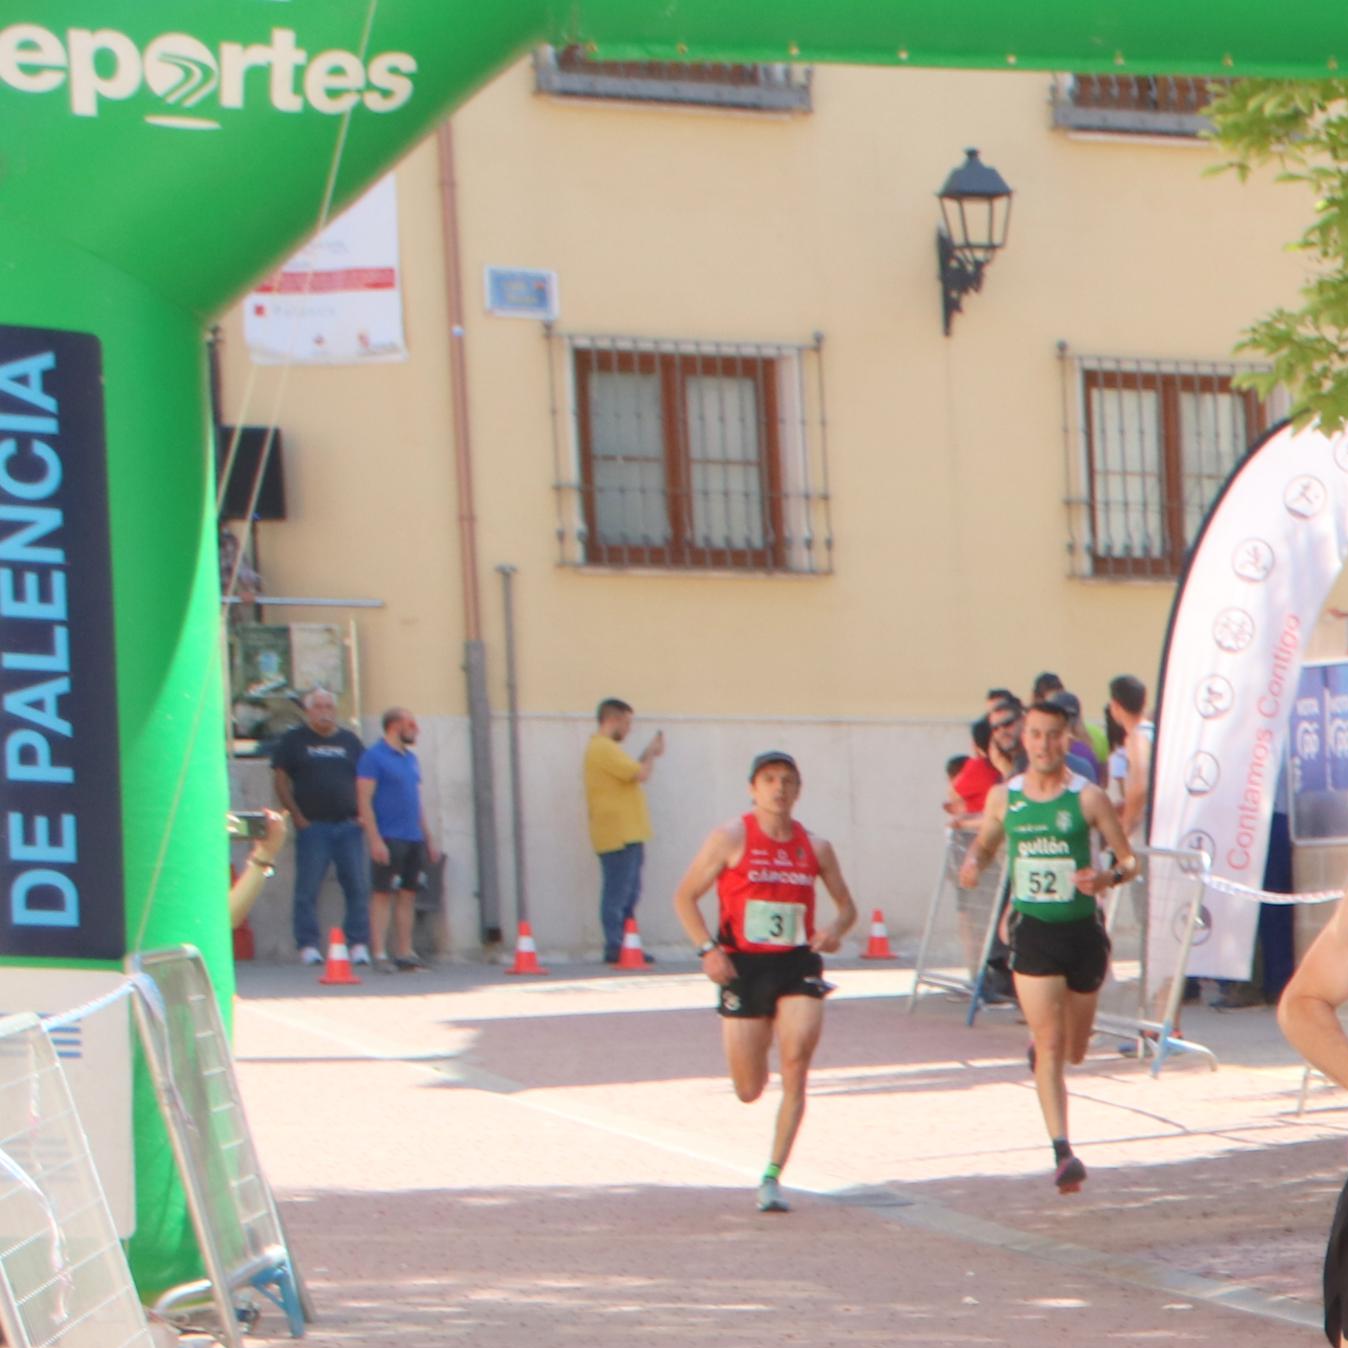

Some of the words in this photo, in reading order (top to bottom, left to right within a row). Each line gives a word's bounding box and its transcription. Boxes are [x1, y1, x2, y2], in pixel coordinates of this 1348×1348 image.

[0, 350, 75, 784] PALENCIA
[1227, 728, 1274, 871] Contamos
[1257, 613, 1301, 719] Contigo
[7, 810, 81, 928] DE
[769, 915, 784, 938] 3
[1029, 870, 1057, 894] 52
